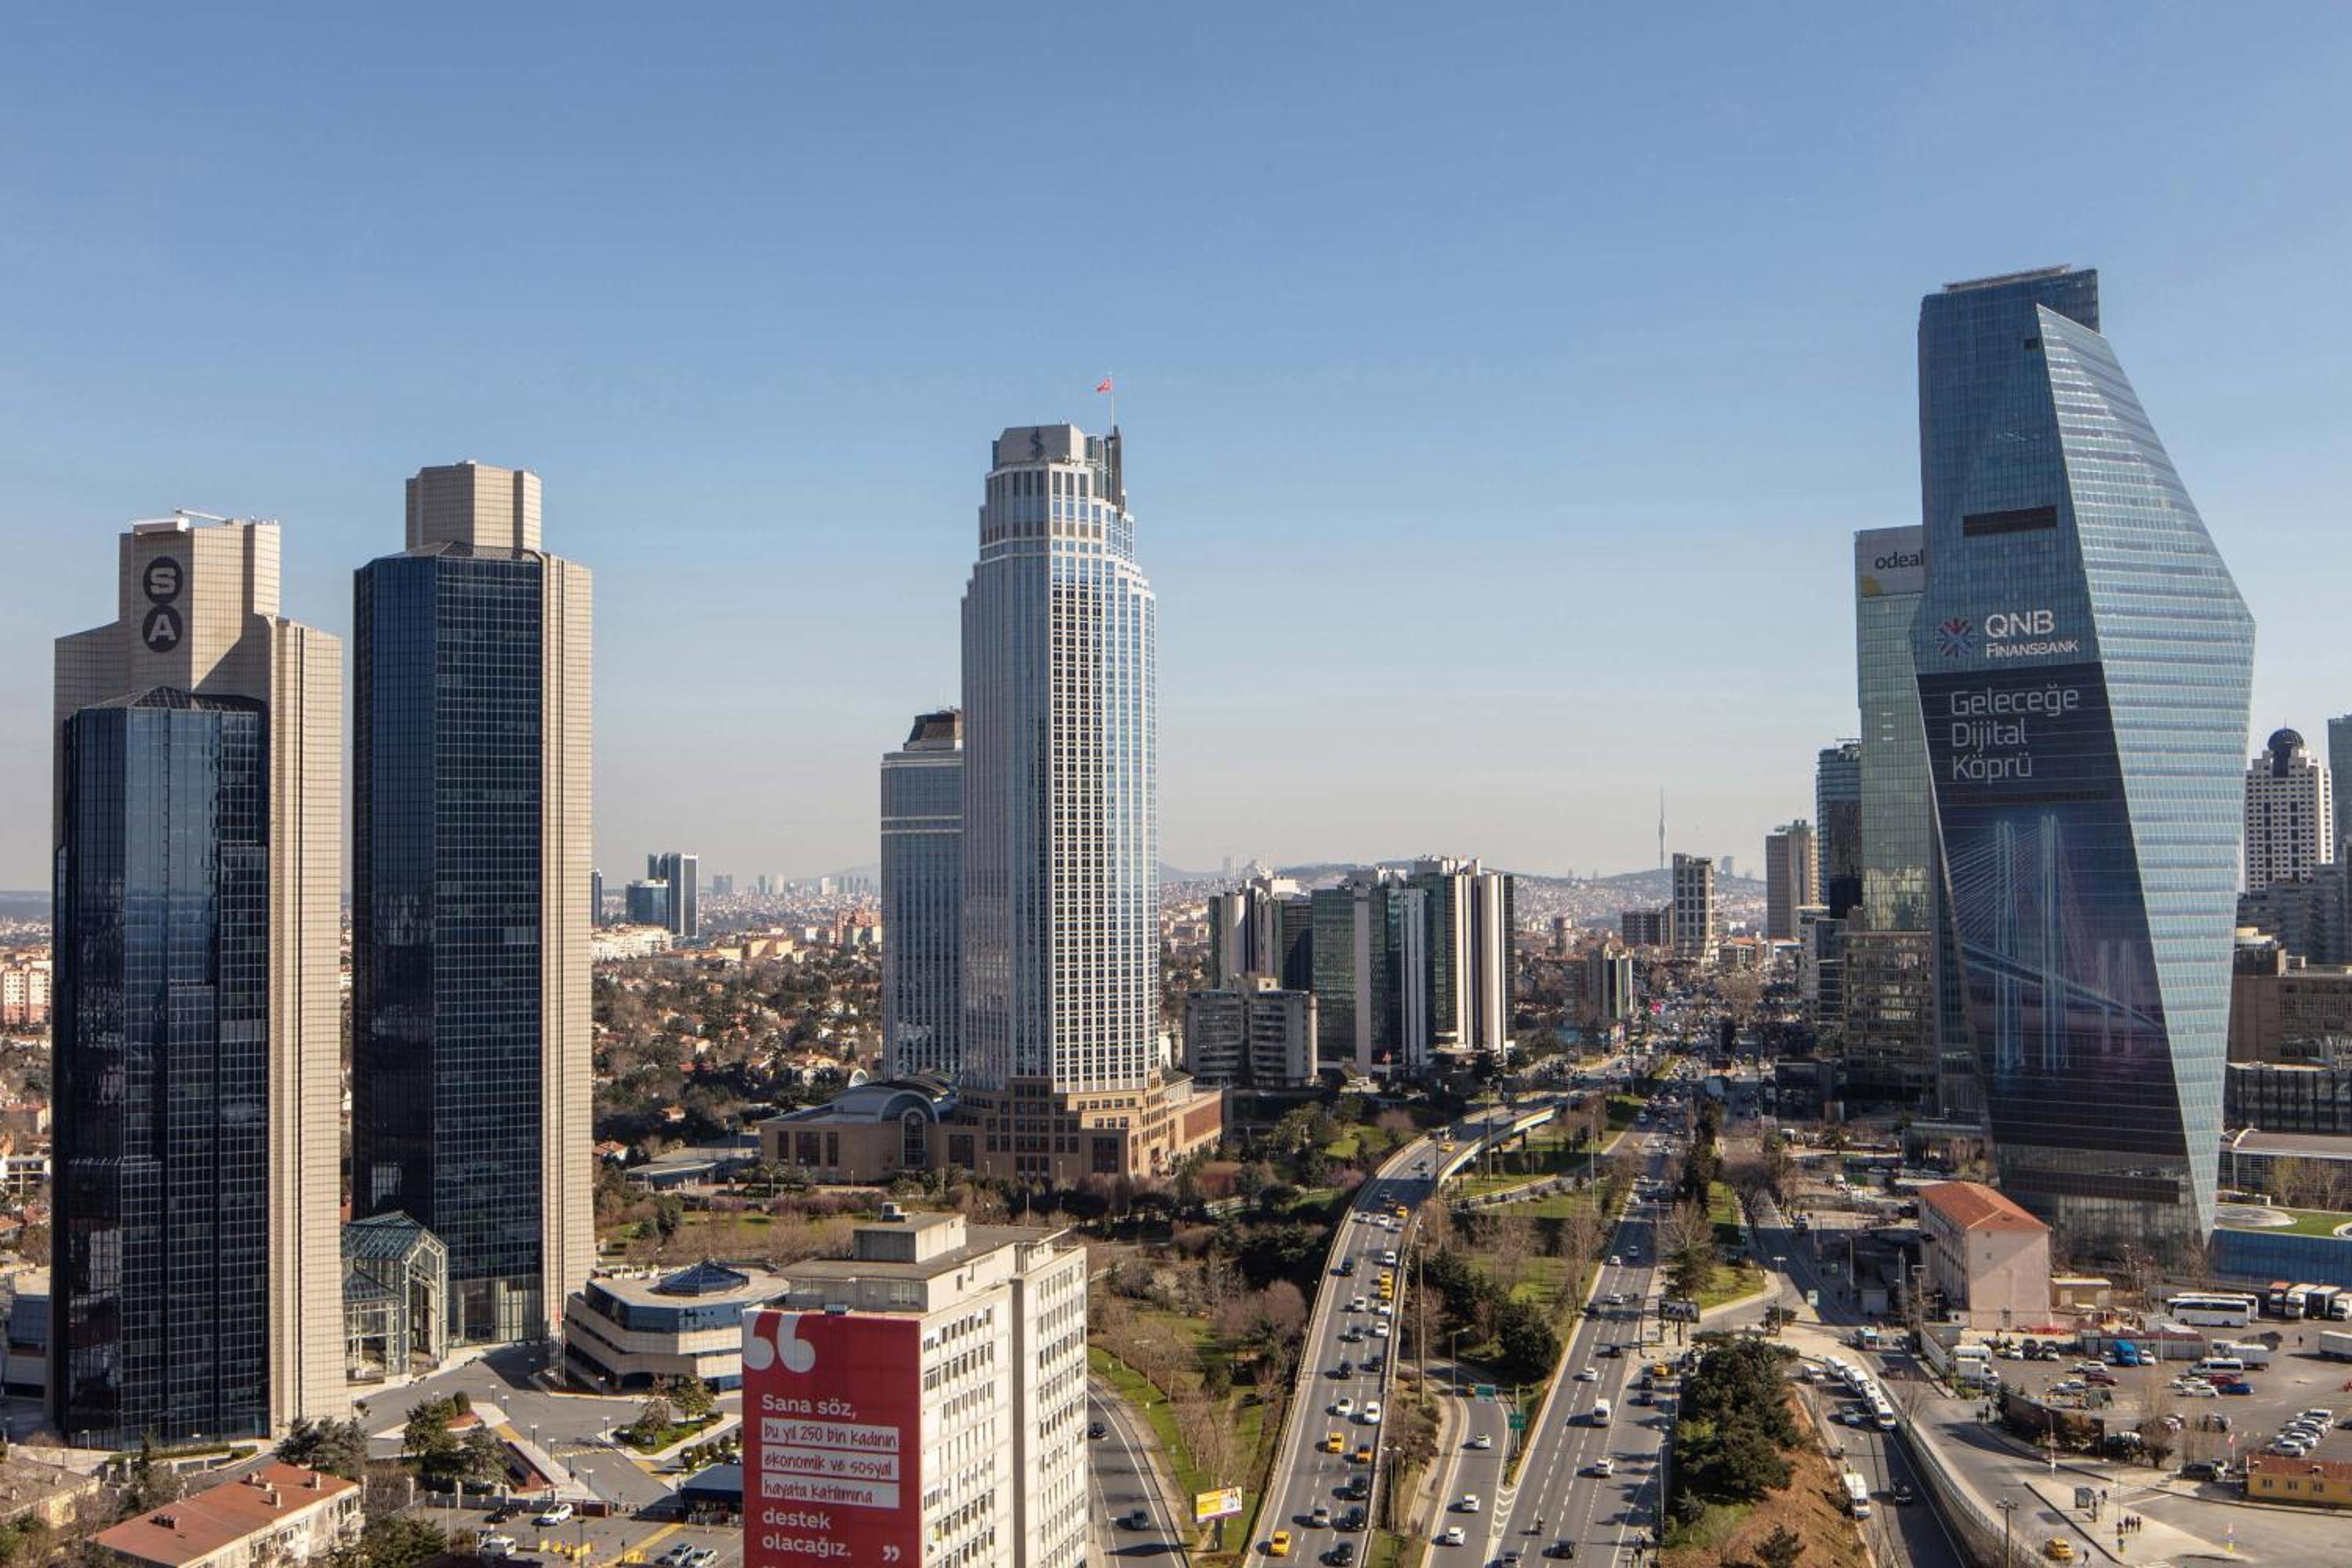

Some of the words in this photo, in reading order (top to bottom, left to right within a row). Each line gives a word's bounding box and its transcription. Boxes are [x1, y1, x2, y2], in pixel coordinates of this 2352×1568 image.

[1985, 610, 2055, 638] QNB
[1986, 640, 2079, 659] FINANSBANK
[1951, 684, 2078, 717] Geleceğe
[1951, 717, 2028, 753] Dijital
[1952, 752, 2032, 784] Köprü
[761, 1394, 811, 1414] Sana
[817, 1398, 857, 1420] söz,
[764, 1422, 779, 1439] bu
[800, 1425, 823, 1442] 250
[827, 1428, 846, 1443] bin
[851, 1430, 897, 1448] kadının
[764, 1451, 826, 1470] ekonomik
[830, 1460, 844, 1472] ve
[851, 1461, 891, 1480] sosyal
[764, 1479, 807, 1498] hayata
[762, 1507, 832, 1530] destek
[762, 1533, 852, 1558] olacağız.
